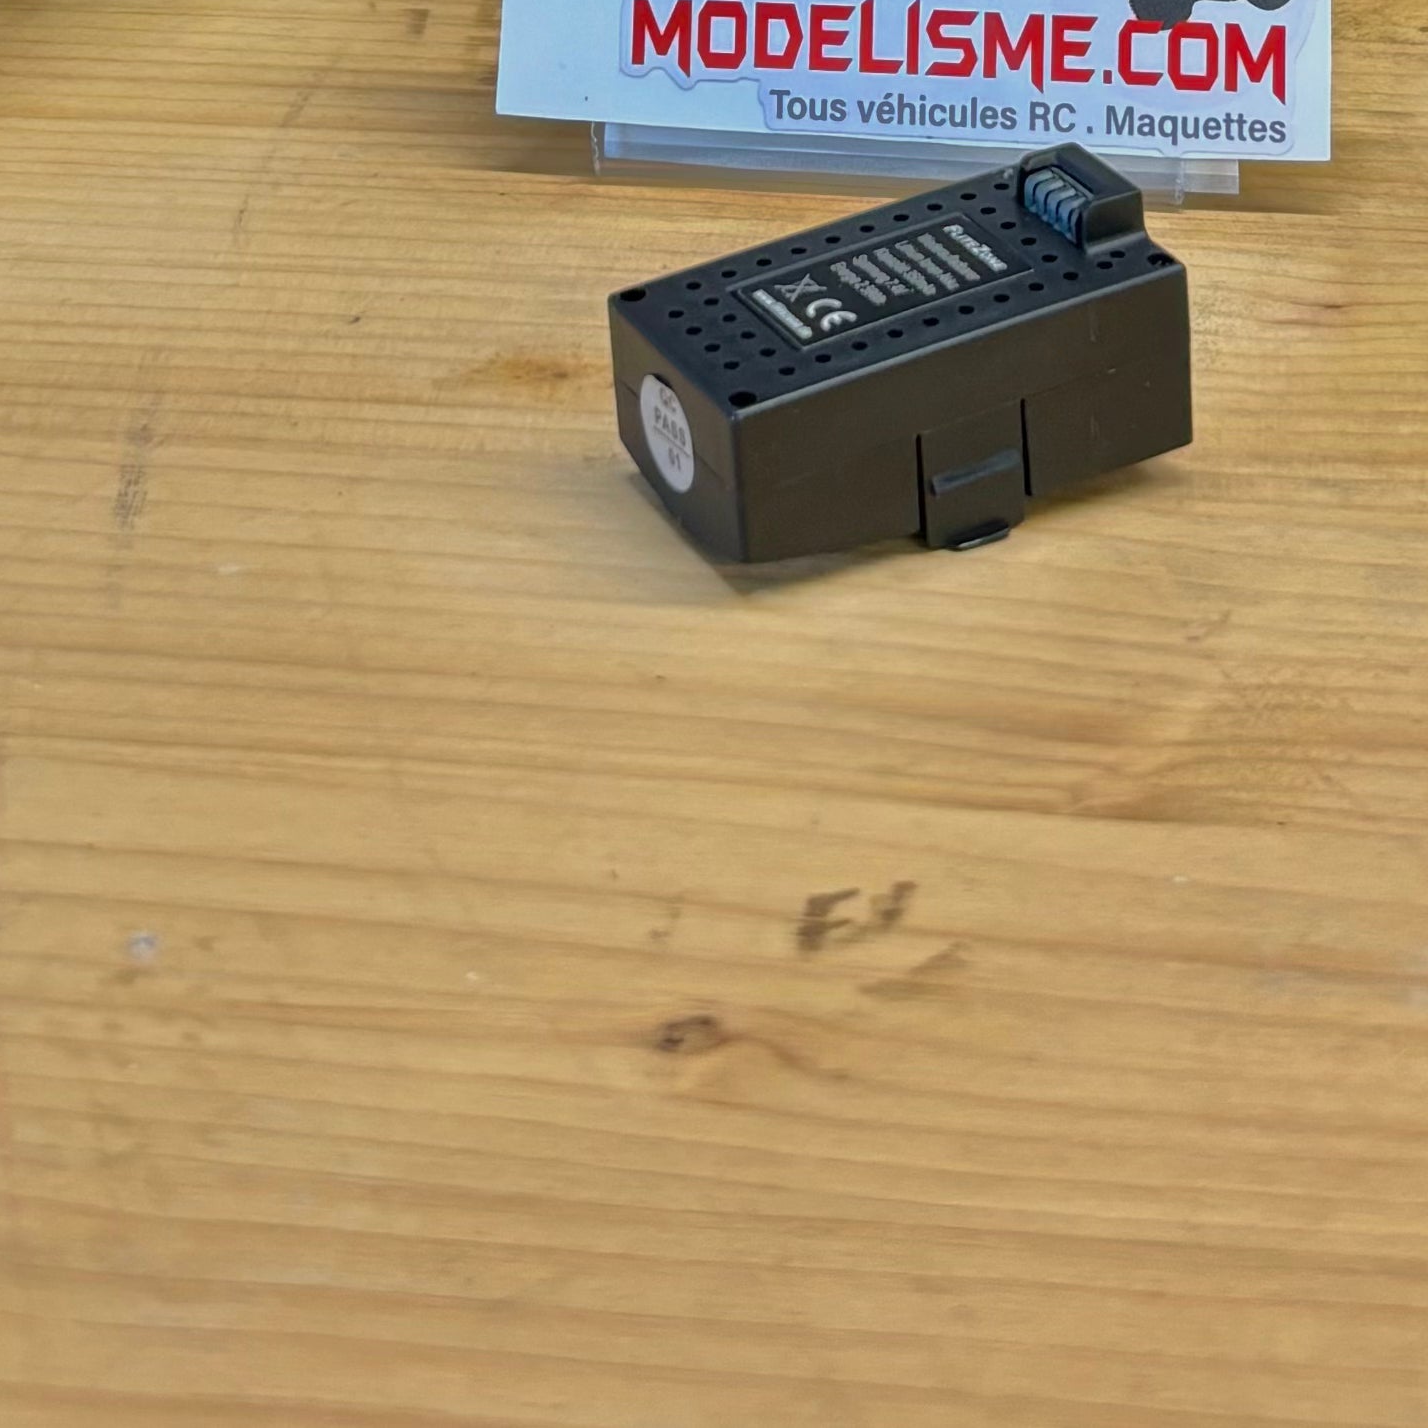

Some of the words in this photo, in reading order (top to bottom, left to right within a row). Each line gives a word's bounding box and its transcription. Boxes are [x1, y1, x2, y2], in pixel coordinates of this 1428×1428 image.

[770, 88, 847, 122] Tous
[857, 92, 1018, 132] véhicules
[1029, 100, 1077, 134] RC
[1105, 104, 1288, 146] Maquettes
